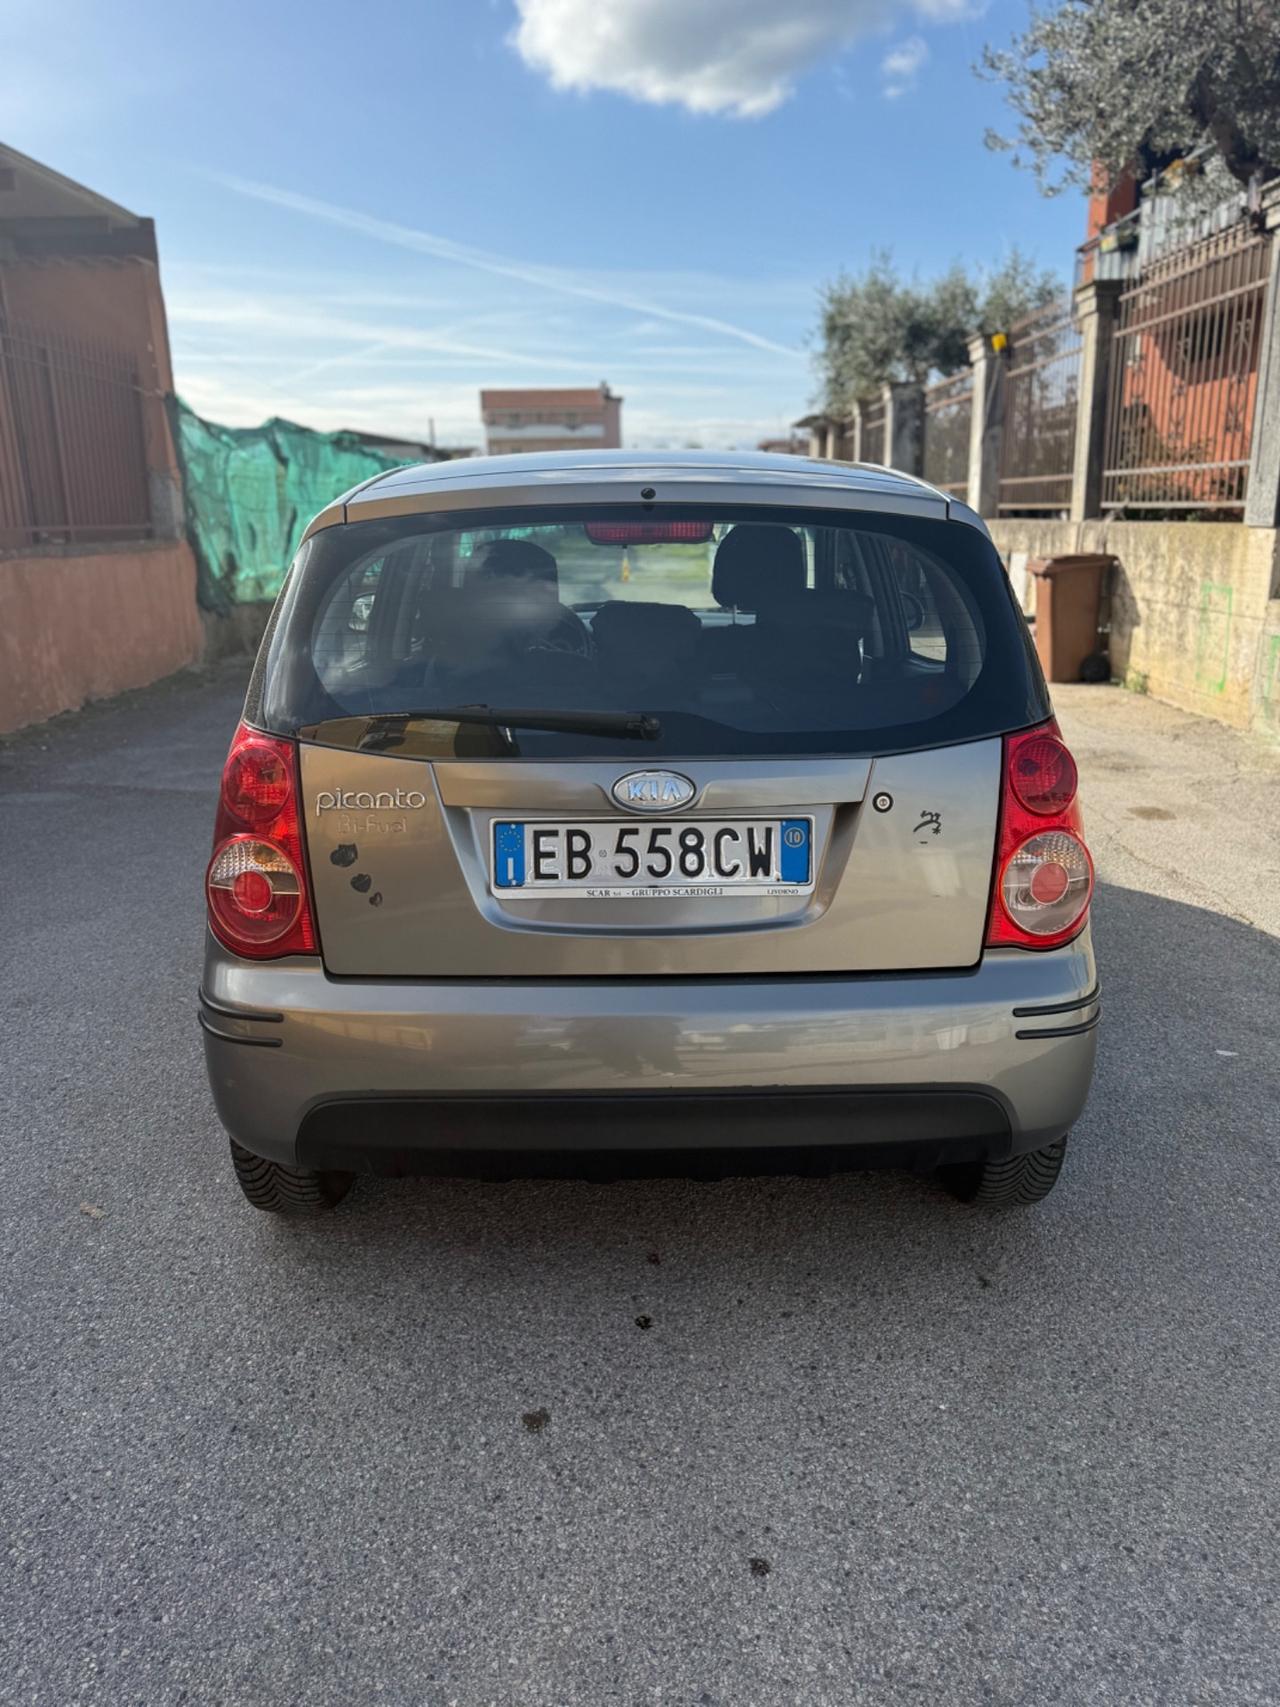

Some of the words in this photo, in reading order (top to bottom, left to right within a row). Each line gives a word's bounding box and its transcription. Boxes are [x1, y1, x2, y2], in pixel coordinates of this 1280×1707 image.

[316, 787, 426, 816] picanto
[626, 780, 683, 802] KIA
[533, 829, 592, 880] EB
[614, 827, 773, 879] 558CW
[788, 831, 801, 843] 10
[586, 889, 611, 897] SCAR
[631, 888, 671, 897] GRUPPO
[673, 887, 723, 896] SCARDIGLI
